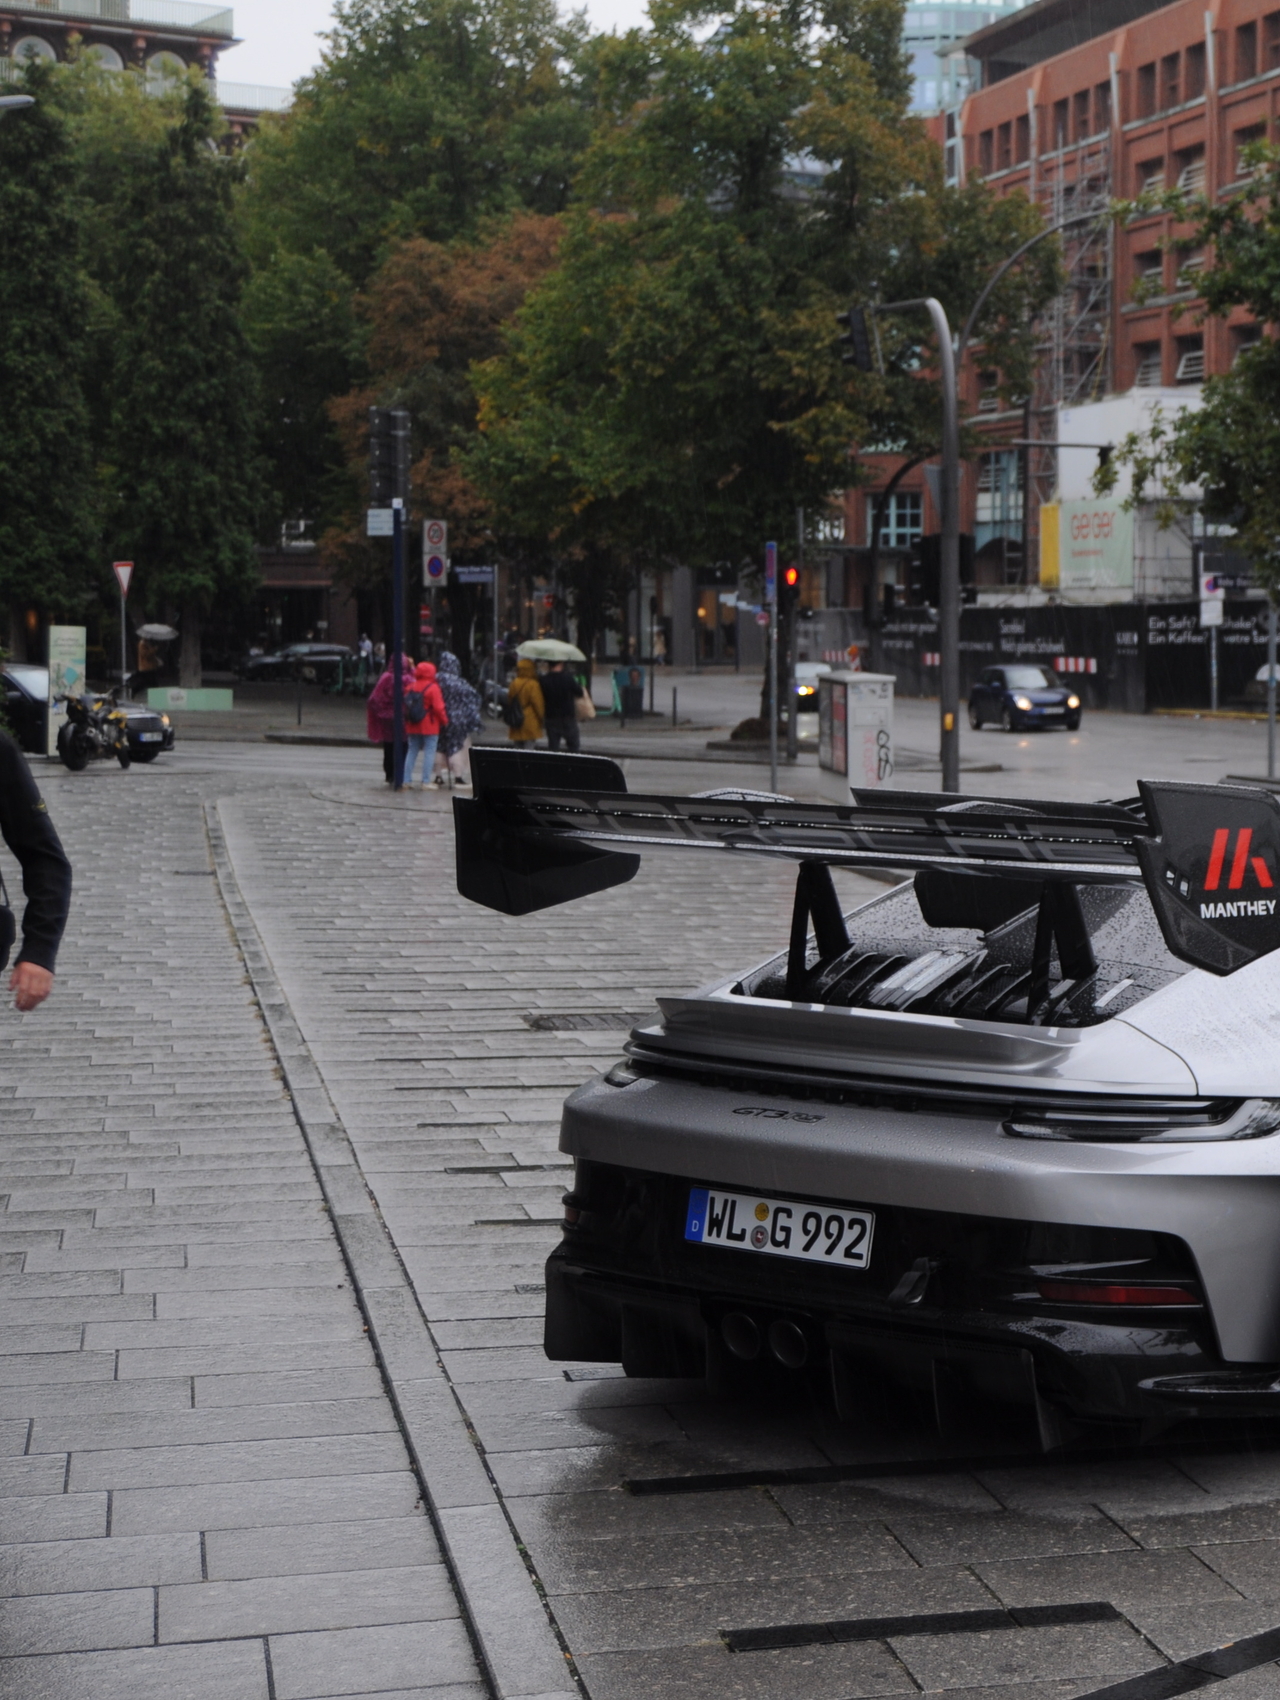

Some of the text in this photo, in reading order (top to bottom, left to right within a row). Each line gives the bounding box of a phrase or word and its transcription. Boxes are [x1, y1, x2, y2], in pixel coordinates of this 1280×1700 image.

[1149, 617, 1165, 629] Ein
[1168, 616, 1197, 629] Saft?
[1148, 632, 1165, 644] Ein
[1168, 631, 1209, 644] Kaffee?
[518, 791, 1138, 863] PORSCHE
[1200, 899, 1277, 919] MANTHEY
[691, 1220, 700, 1232] D
[708, 1196, 747, 1243] WL
